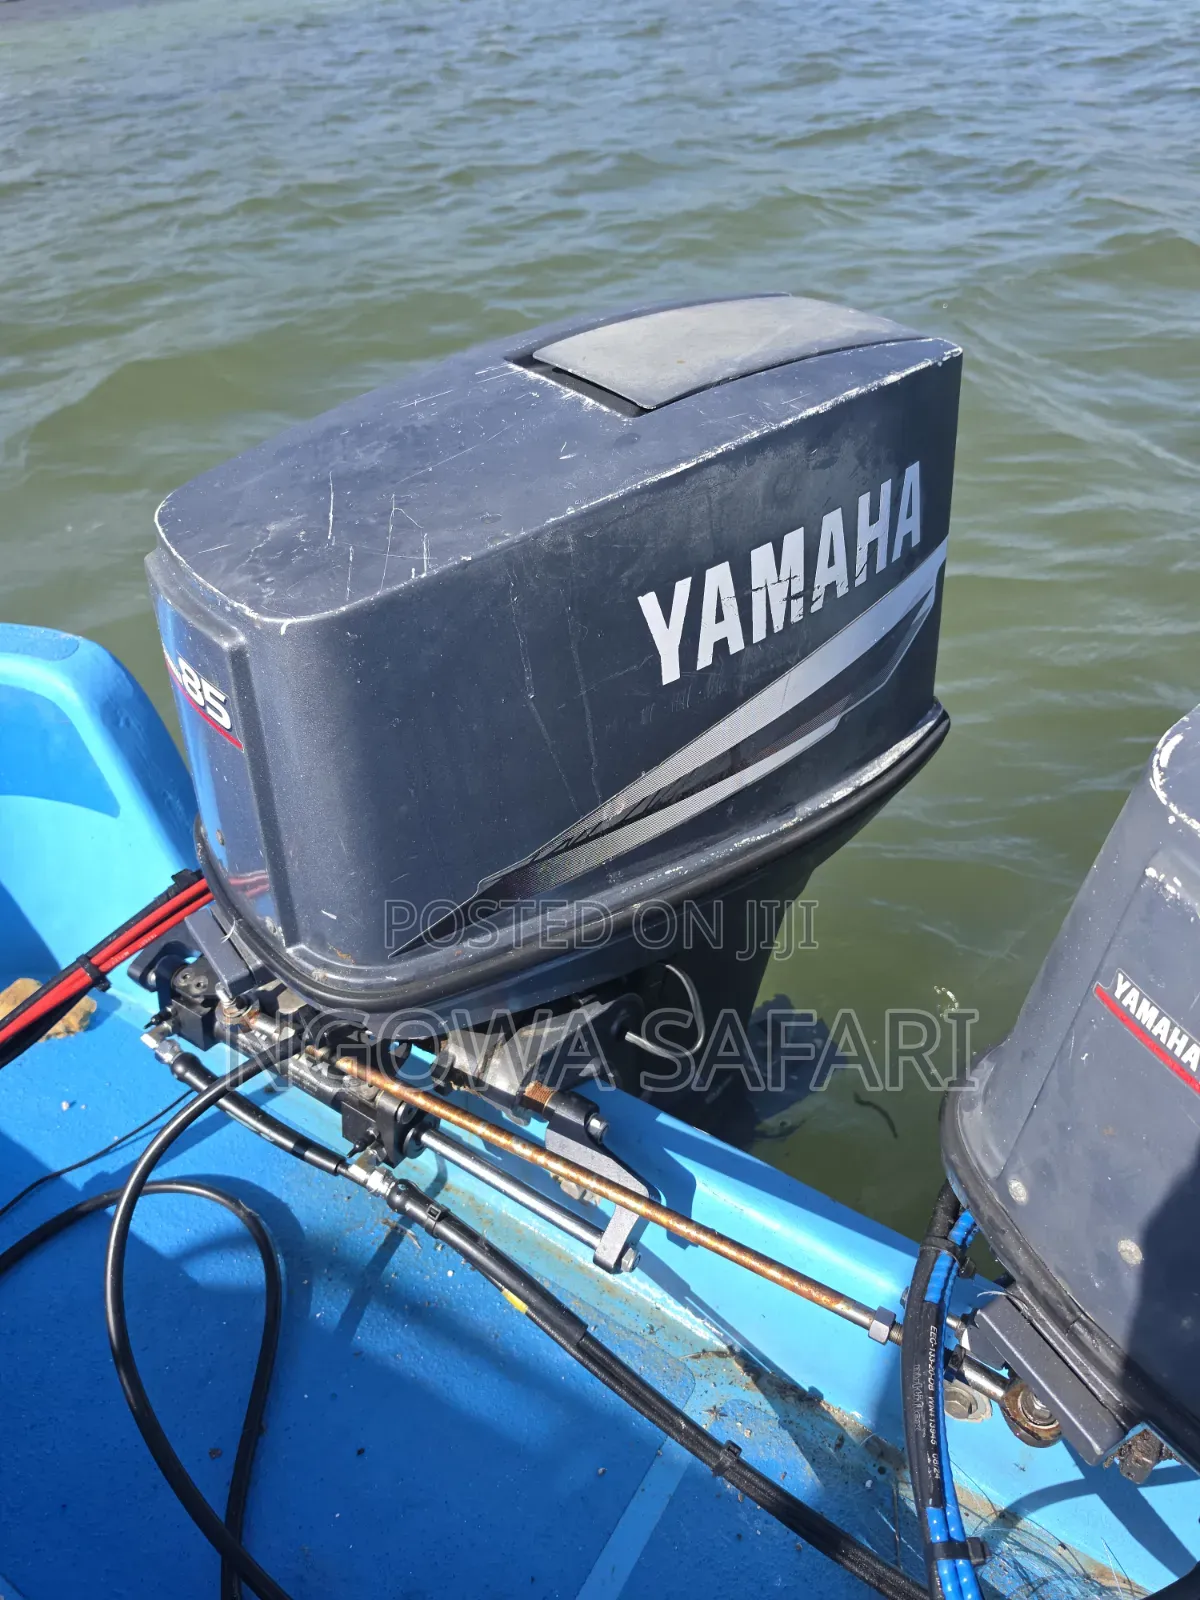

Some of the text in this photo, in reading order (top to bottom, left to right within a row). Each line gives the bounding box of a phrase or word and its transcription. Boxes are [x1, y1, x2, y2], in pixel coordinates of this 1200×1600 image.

[637, 461, 921, 686] YAMAHA
[178, 656, 231, 731] 85
[1114, 973, 1200, 1072] YAMAHA
